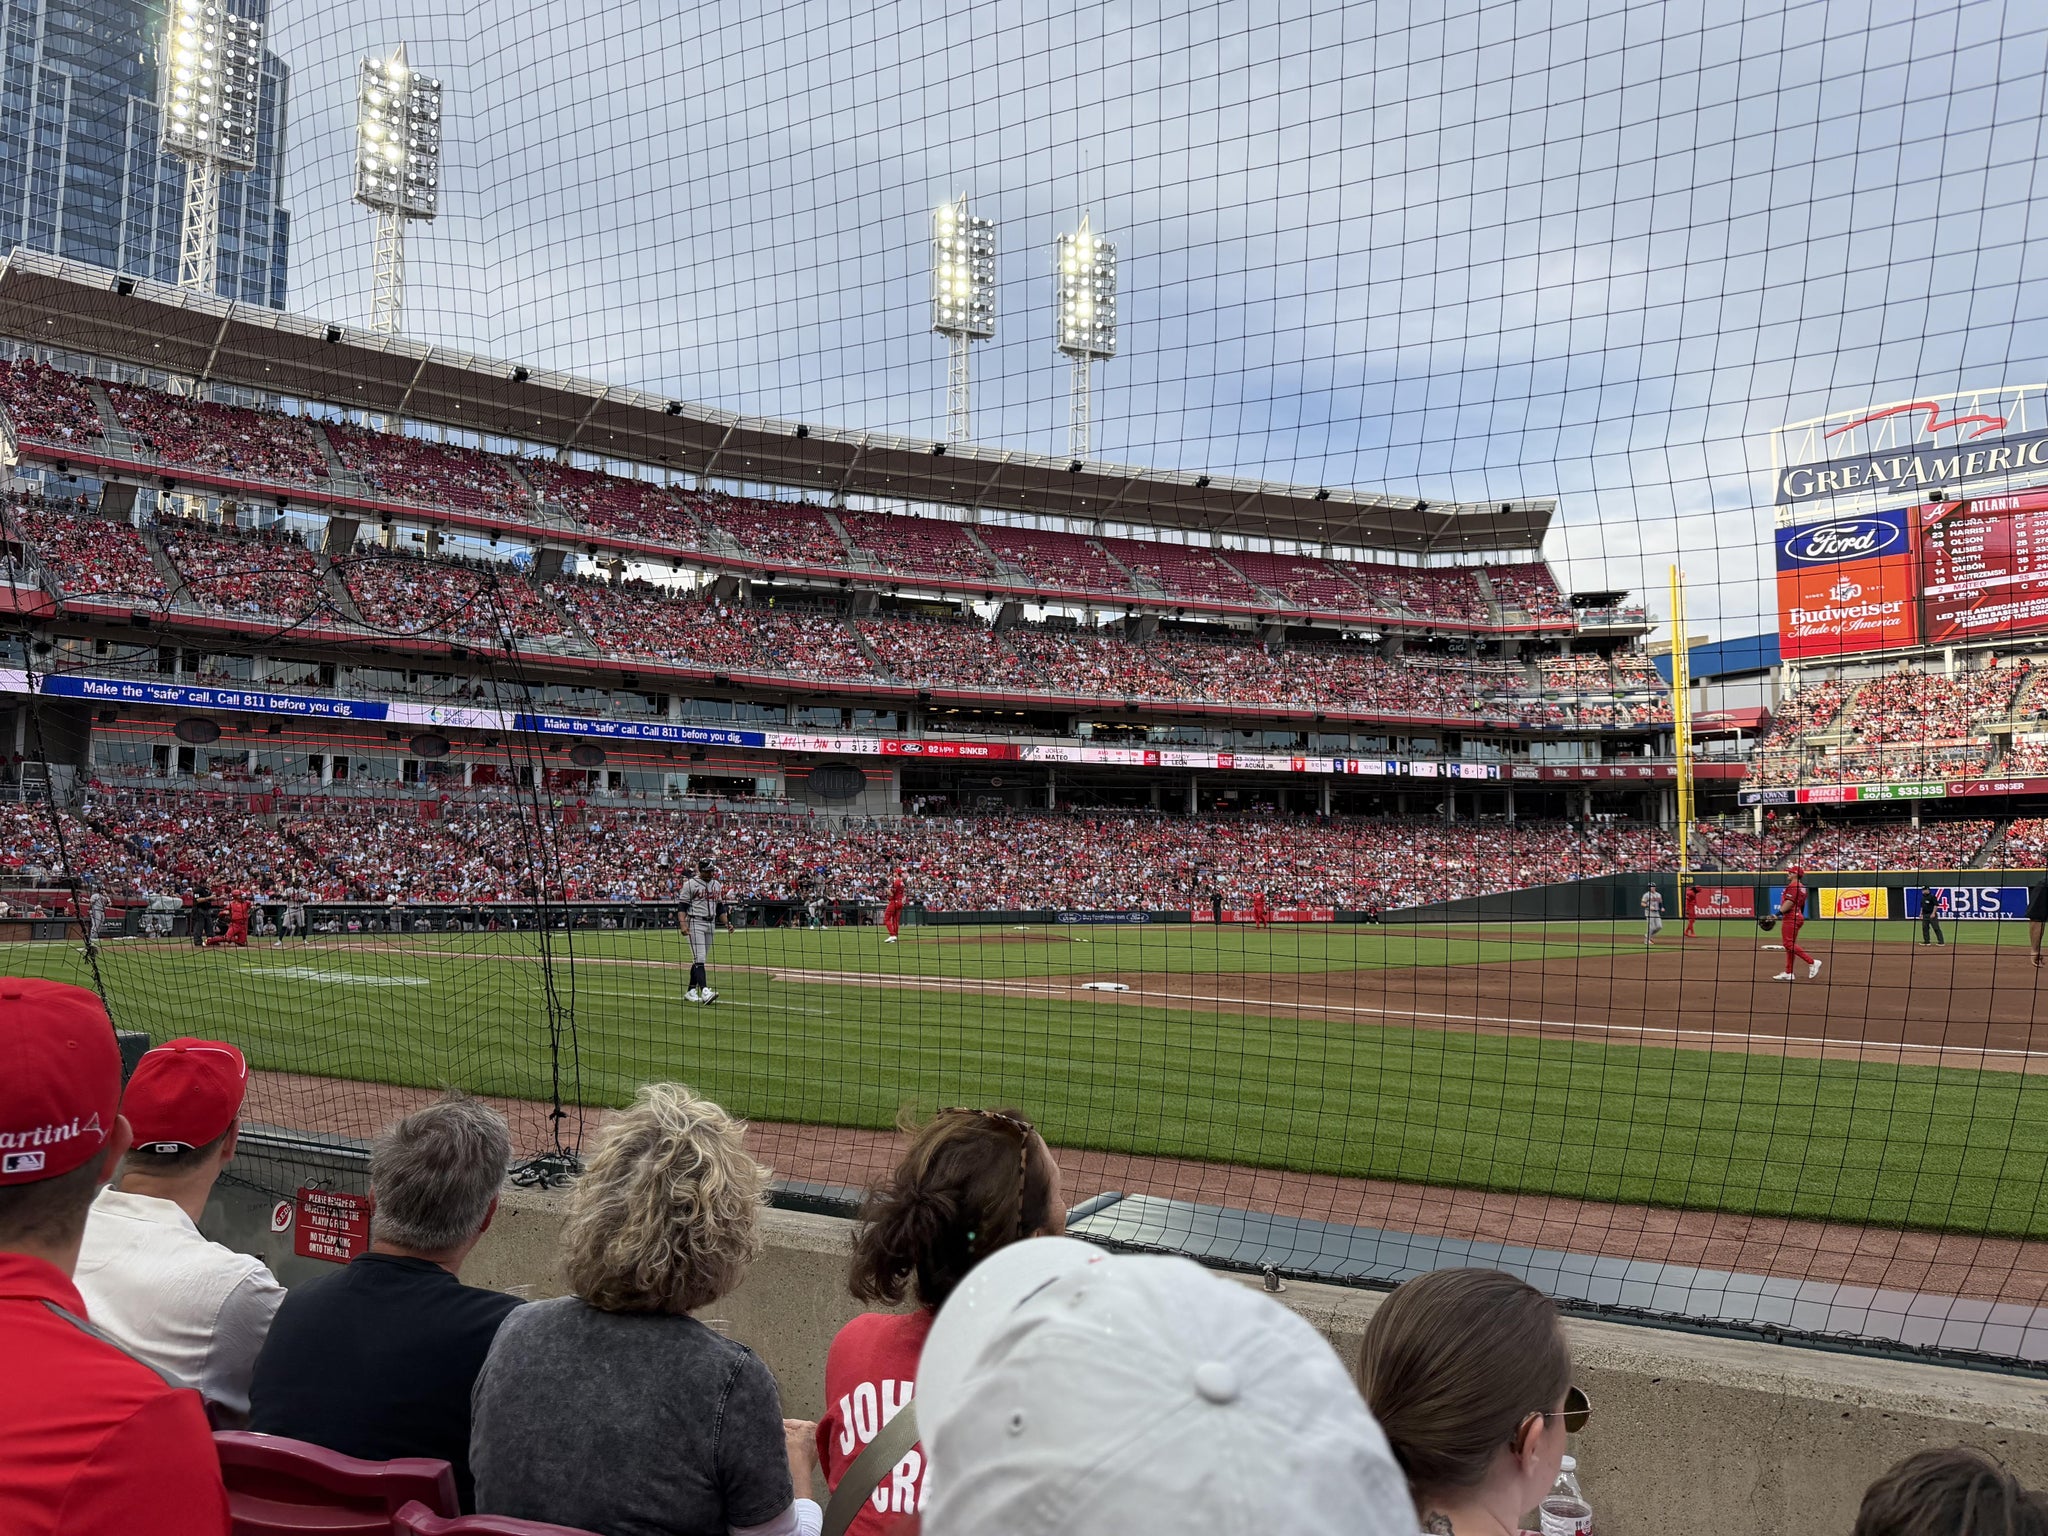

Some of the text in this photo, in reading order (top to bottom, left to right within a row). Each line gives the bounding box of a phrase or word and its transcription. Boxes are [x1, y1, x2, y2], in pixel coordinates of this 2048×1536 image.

[1897, 439, 2048, 488] AMERIC
[1970, 497, 2020, 513] ATLANTA
[1806, 525, 1876, 556] Ford
[1932, 531, 1944, 539] 23
[1950, 527, 1984, 537] HARRIS
[1950, 536, 1984, 546] OLSON
[1951, 545, 1984, 555] ALBIES
[1952, 554, 1982, 564] SMITH
[1952, 568, 2007, 582] YASTRZEMSKI
[2018, 565, 2029, 573] LF
[1953, 580, 1987, 590] MATEO
[1789, 600, 1904, 625] Budweiser
[1936, 598, 2048, 621] LED THE AMERICAN LEAGU
[1955, 613, 1989, 624] STOLEN
[1990, 608, 2019, 619] BASES
[1788, 616, 1902, 638] Made of America
[1962, 617, 1999, 628] MEMBER
[2013, 612, 2030, 620] THE
[83, 681, 118, 695] Make
[122, 685, 142, 697] the
[188, 691, 213, 703] call.
[217, 692, 239, 706] Call
[244, 695, 265, 708] 811
[270, 698, 305, 710] before
[309, 702, 329, 713] you
[333, 702, 353, 716] dig.
[544, 718, 570, 730] Make
[573, 720, 588, 731] the
[621, 725, 640, 735] call.
[642, 725, 659, 737] Call
[662, 727, 678, 738] 811
[681, 728, 708, 739] before
[710, 732, 725, 742] you
[727, 732, 742, 743] dig.
[781, 736, 797, 747] ATL
[813, 738, 828, 749] CIN
[835, 740, 841, 749] 0
[851, 744, 857, 752] 3
[873, 745, 878, 753] 2
[928, 745, 988, 755] 92 MPH SINKER
[1979, 783, 1989, 792] 51
[1994, 782, 2025, 791] SINGER
[0, 1117, 80, 1148] artini
[308, 1194, 327, 1205] PLEASE
[349, 1200, 357, 1209] OF
[276, 1203, 292, 1225] REDS
[312, 1215, 333, 1228] PLAYING
[349, 1210, 360, 1222] THE
[310, 1232, 318, 1242] NO
[309, 1242, 323, 1254] ONTO
[323, 1245, 333, 1256] THE
[839, 1379, 914, 1456] JOH
